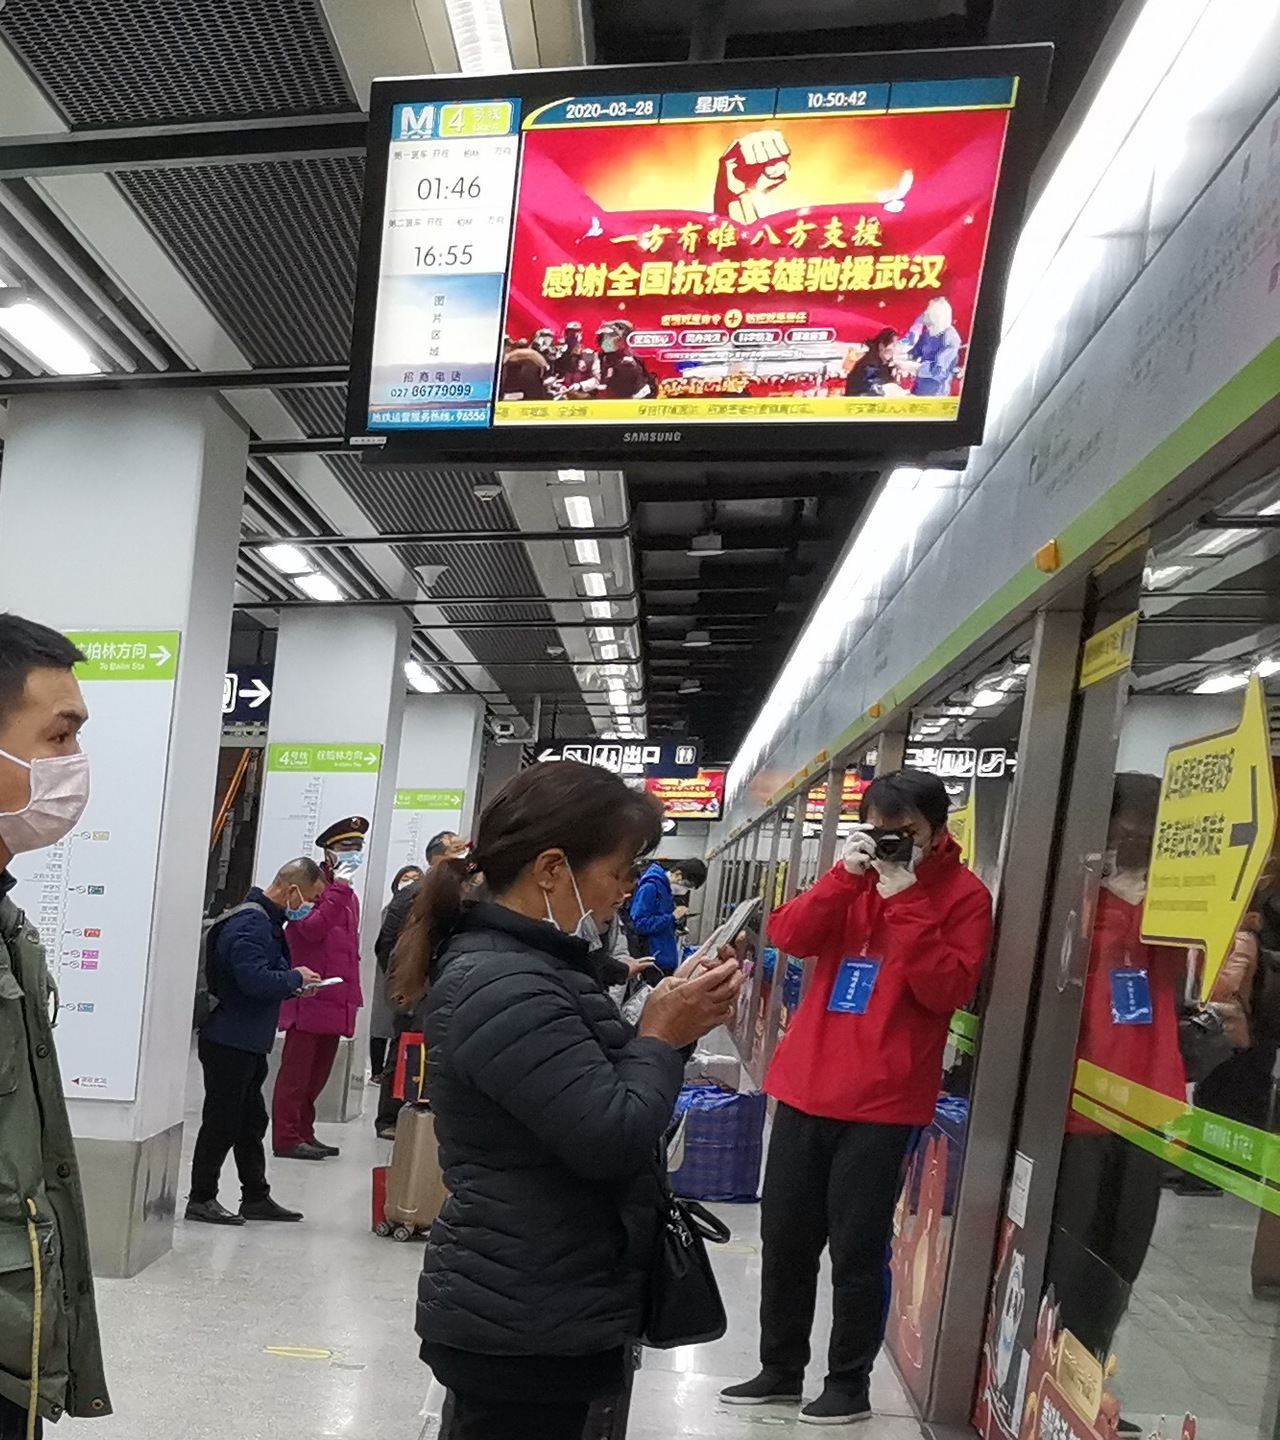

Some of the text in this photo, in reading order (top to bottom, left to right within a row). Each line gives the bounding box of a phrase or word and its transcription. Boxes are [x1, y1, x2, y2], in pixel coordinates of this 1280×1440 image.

[566, 98, 653, 119] 2020-03-28
[694, 94, 746, 115] 星期六
[807, 89, 868, 109] 10:50:42
[417, 176, 481, 200] 01:46
[609, 216, 884, 255] 一方有难 八方支援
[414, 243, 474, 269] 16:55
[541, 252, 946, 300] 感谢全国抗疫英雄驰援武汉
[391, 388, 409, 397] 027
[623, 431, 683, 444] SAMSUNG
[624, 746, 661, 763] 出口
